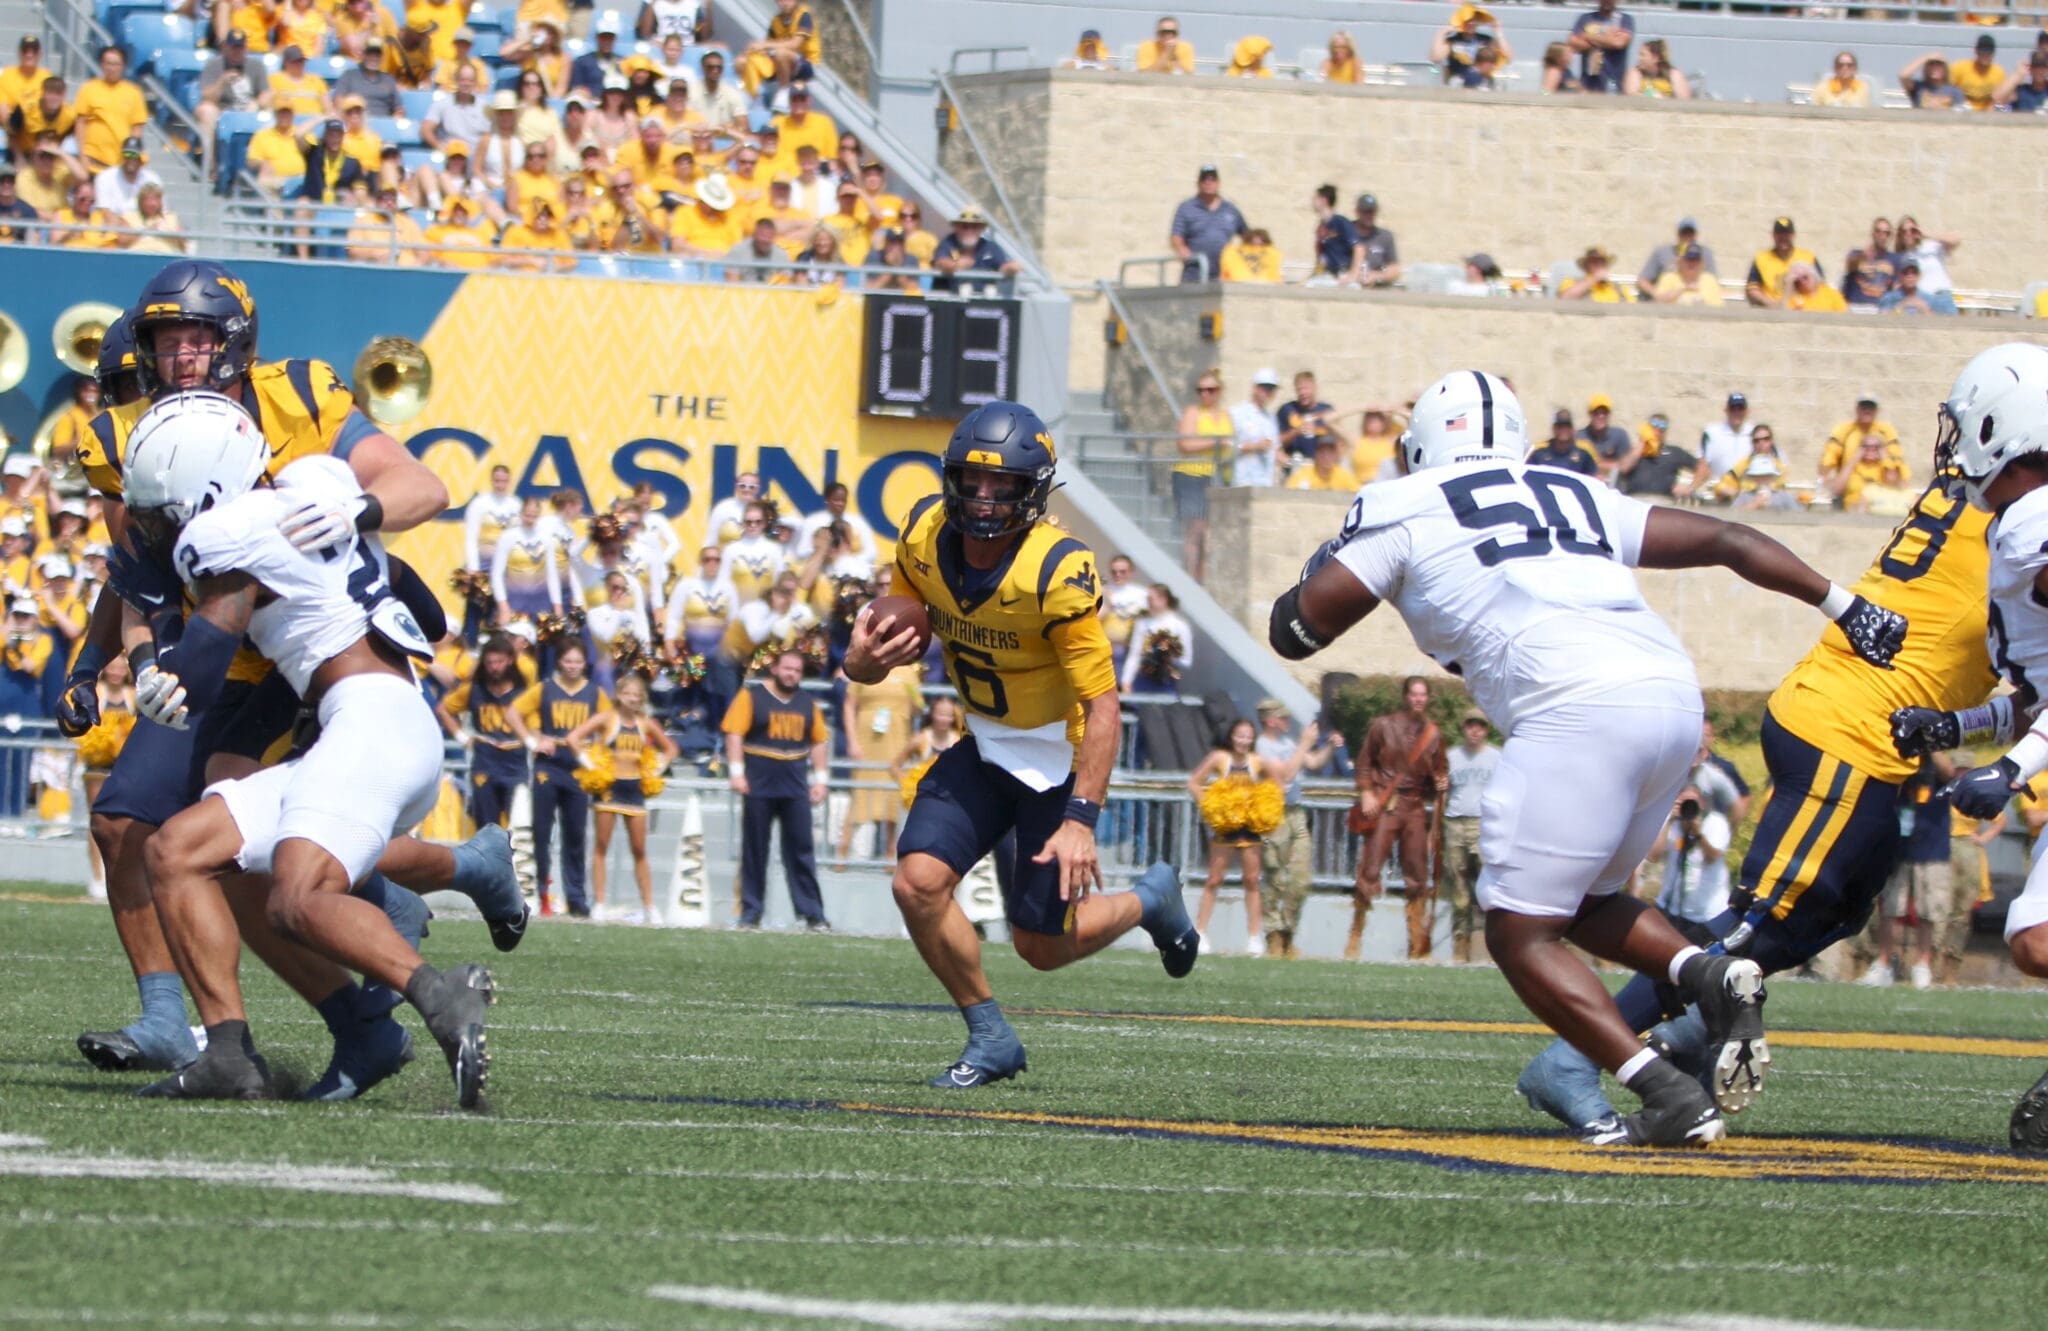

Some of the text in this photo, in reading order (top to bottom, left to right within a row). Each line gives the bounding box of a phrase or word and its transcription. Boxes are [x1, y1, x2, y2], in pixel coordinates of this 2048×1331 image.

[879, 304, 1009, 404] 03
[652, 393, 727, 421] THE
[1439, 467, 1613, 567] 50
[949, 639, 1009, 718] 6
[769, 711, 805, 742] WVU
[680, 833, 705, 908] WVU
